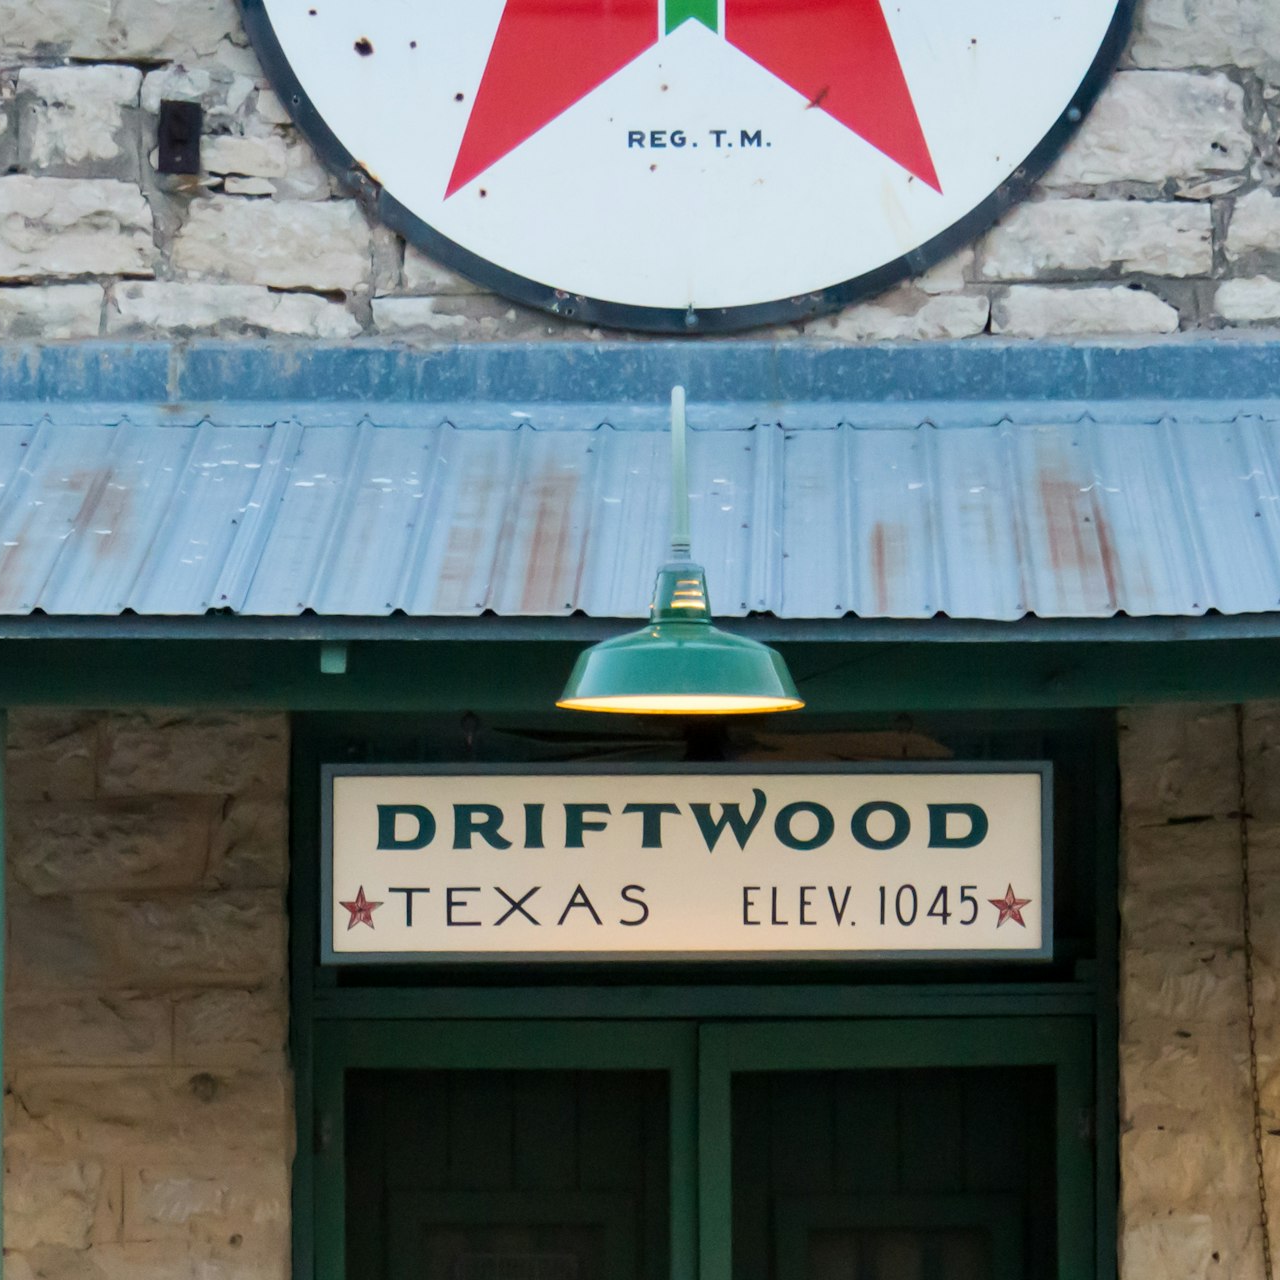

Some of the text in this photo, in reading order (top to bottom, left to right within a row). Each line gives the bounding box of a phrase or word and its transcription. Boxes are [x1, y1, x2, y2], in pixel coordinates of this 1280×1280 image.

[626, 129, 699, 149] REG.
[376, 787, 990, 854] DRIFTWOOD
[387, 884, 651, 928] TEXAS
[743, 884, 980, 928] ELEV. 1045
